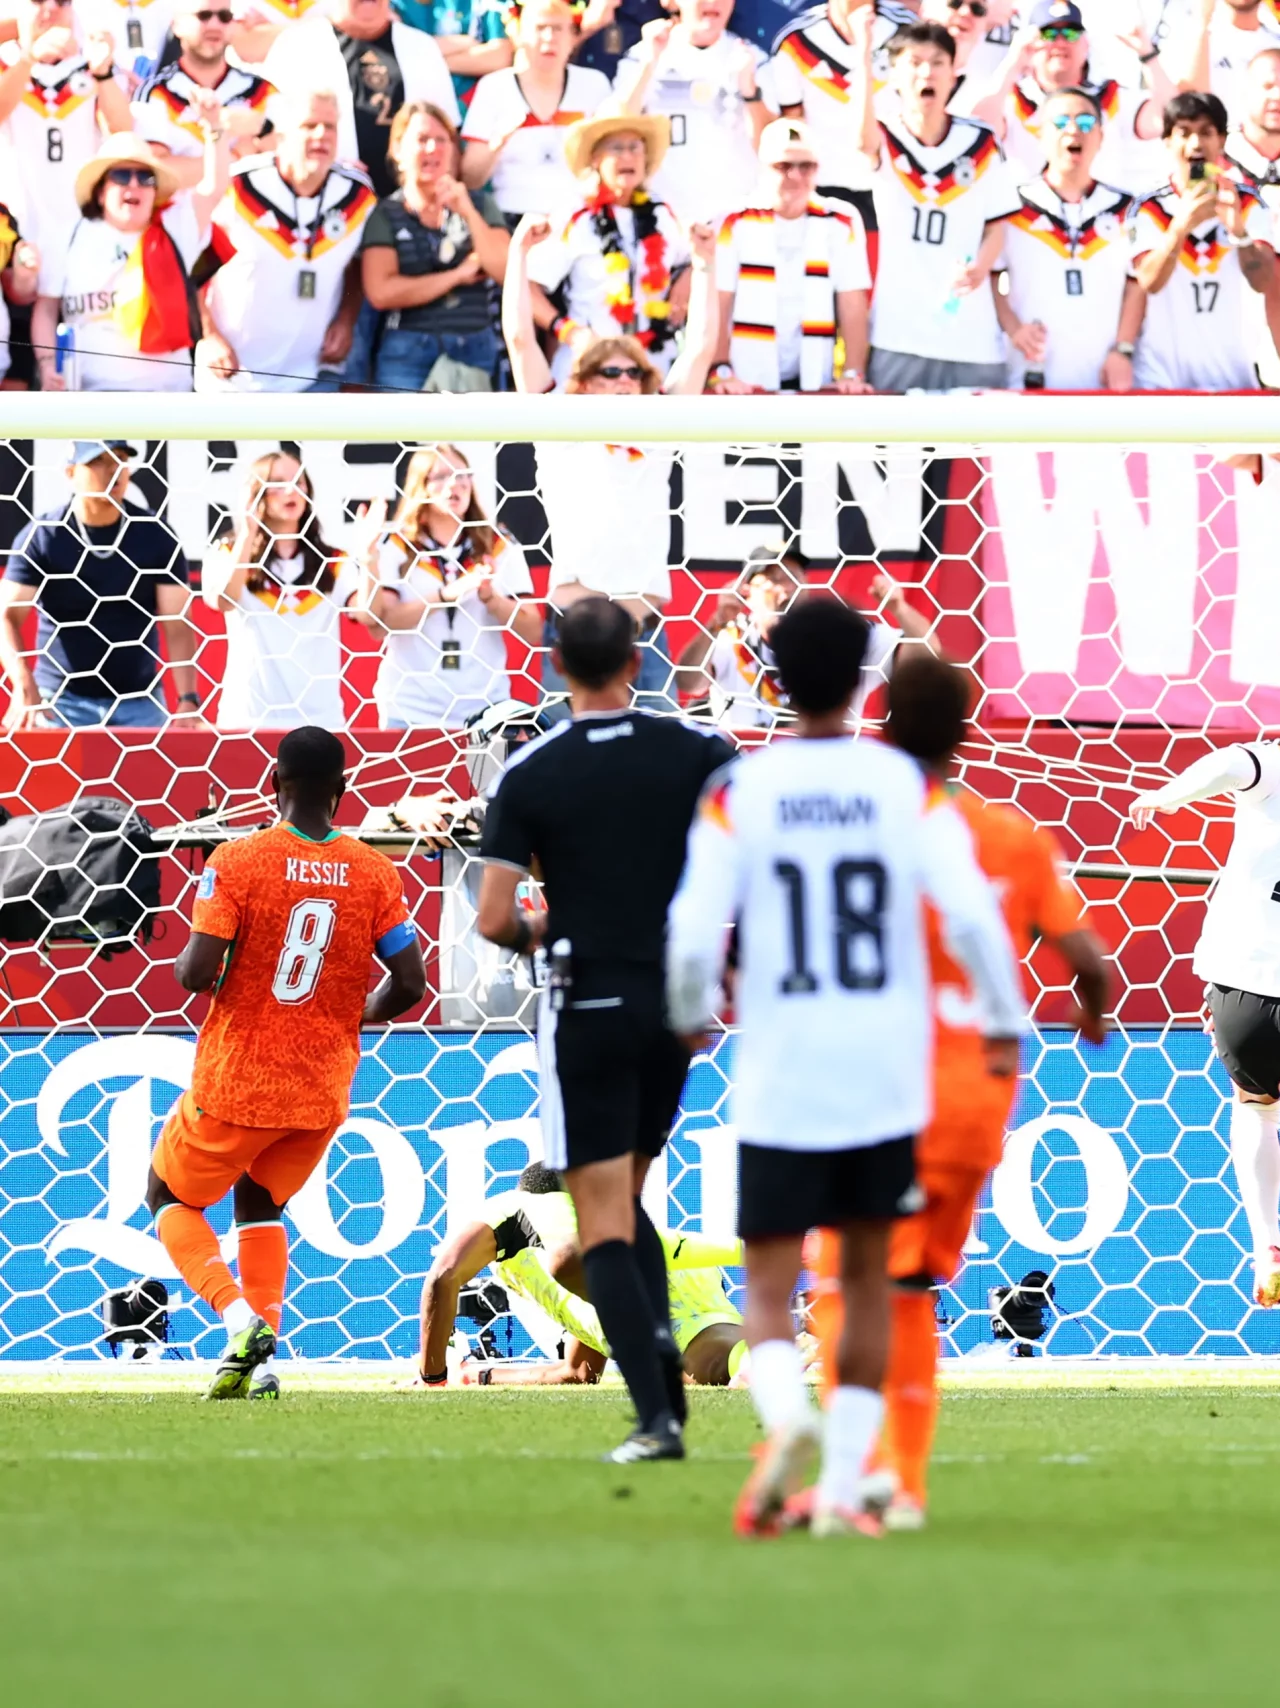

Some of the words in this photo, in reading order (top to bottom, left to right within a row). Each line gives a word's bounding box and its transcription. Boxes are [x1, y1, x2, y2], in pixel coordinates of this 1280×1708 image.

[47, 127, 63, 161] 8
[911, 205, 946, 245] 10
[1192, 281, 1220, 313] 17
[286, 857, 349, 887] KESSIE
[774, 858, 888, 994] 18
[271, 897, 337, 1006] 8
